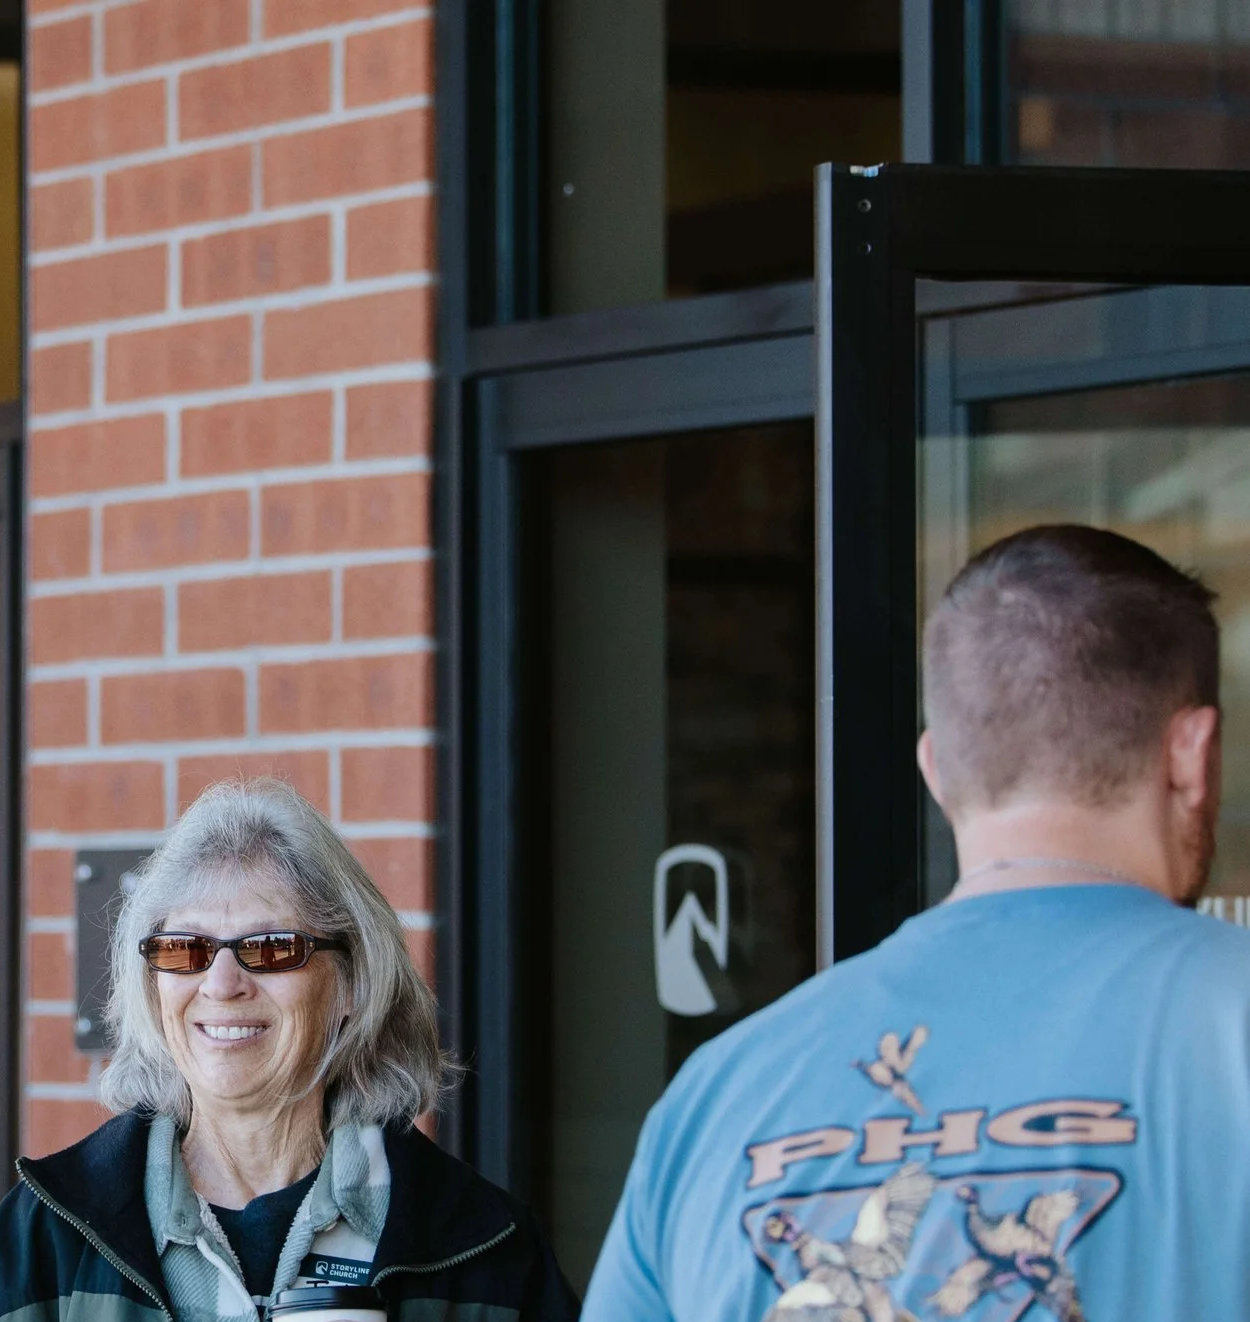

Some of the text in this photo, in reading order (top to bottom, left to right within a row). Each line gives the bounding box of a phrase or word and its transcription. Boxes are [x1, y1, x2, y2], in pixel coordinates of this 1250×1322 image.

[745, 1098, 1138, 1189] PHG
[329, 1270, 358, 1279] CHURCH
[330, 1263, 370, 1275] STORYLINE
